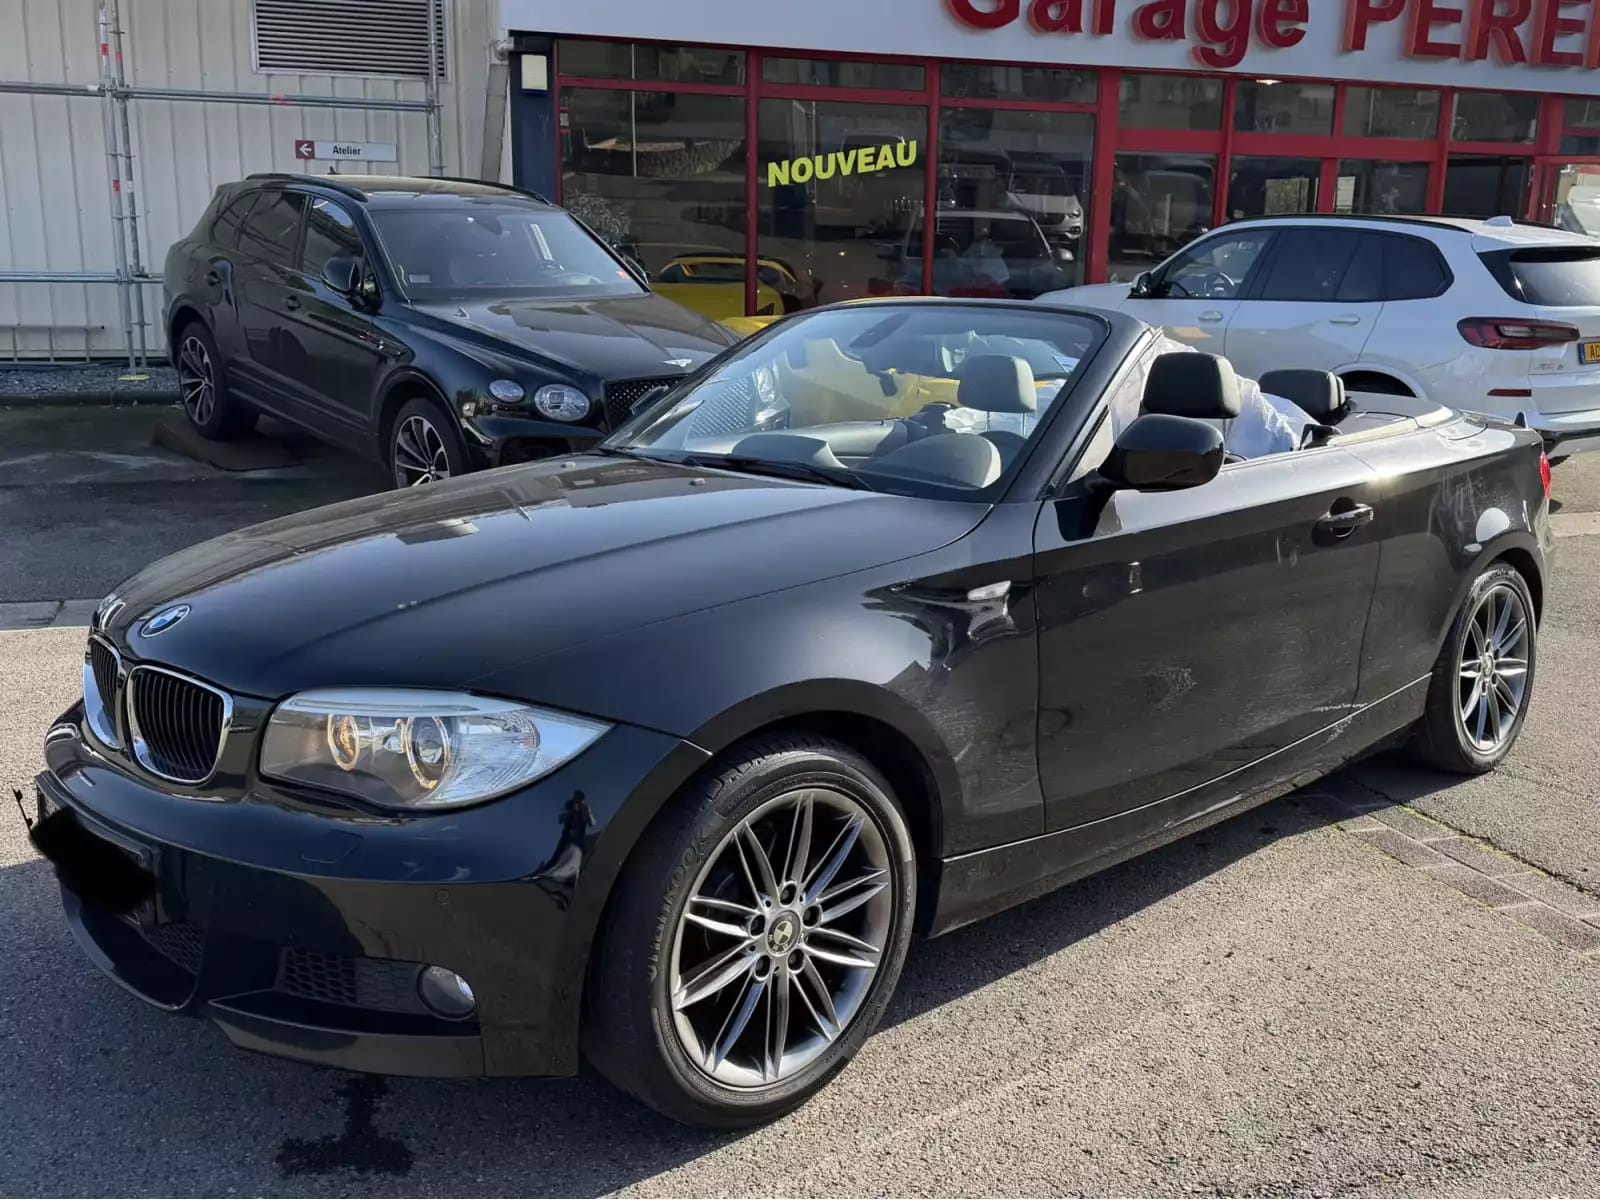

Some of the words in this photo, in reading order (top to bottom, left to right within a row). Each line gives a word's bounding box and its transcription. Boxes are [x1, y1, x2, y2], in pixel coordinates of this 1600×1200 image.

[1343, 0, 1600, 68] PERE
[333, 145, 361, 156] Atelier
[767, 140, 918, 188] NOUVEAU
